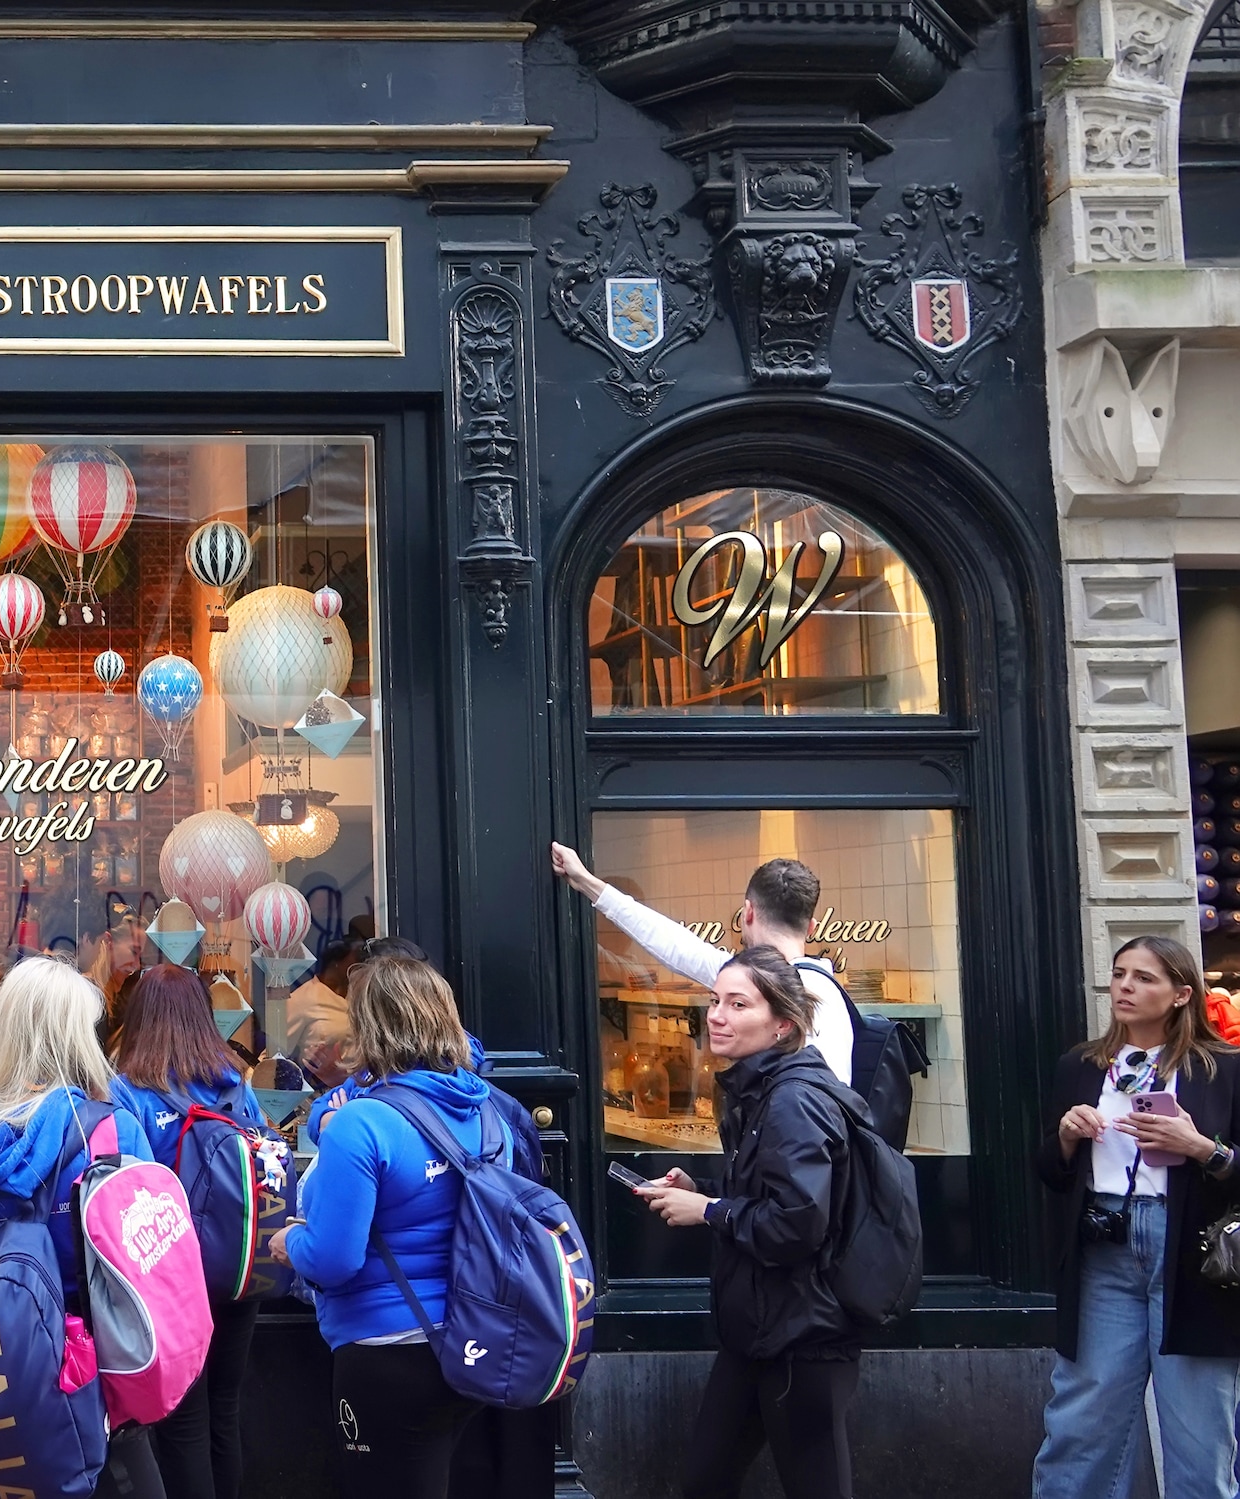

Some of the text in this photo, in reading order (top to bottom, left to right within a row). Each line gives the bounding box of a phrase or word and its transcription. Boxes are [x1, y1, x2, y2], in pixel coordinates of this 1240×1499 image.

[672, 530, 845, 670] W
[679, 920, 726, 944] an
[133, 1209, 176, 1255] We Are
[139, 1216, 191, 1275] Amsterdam
